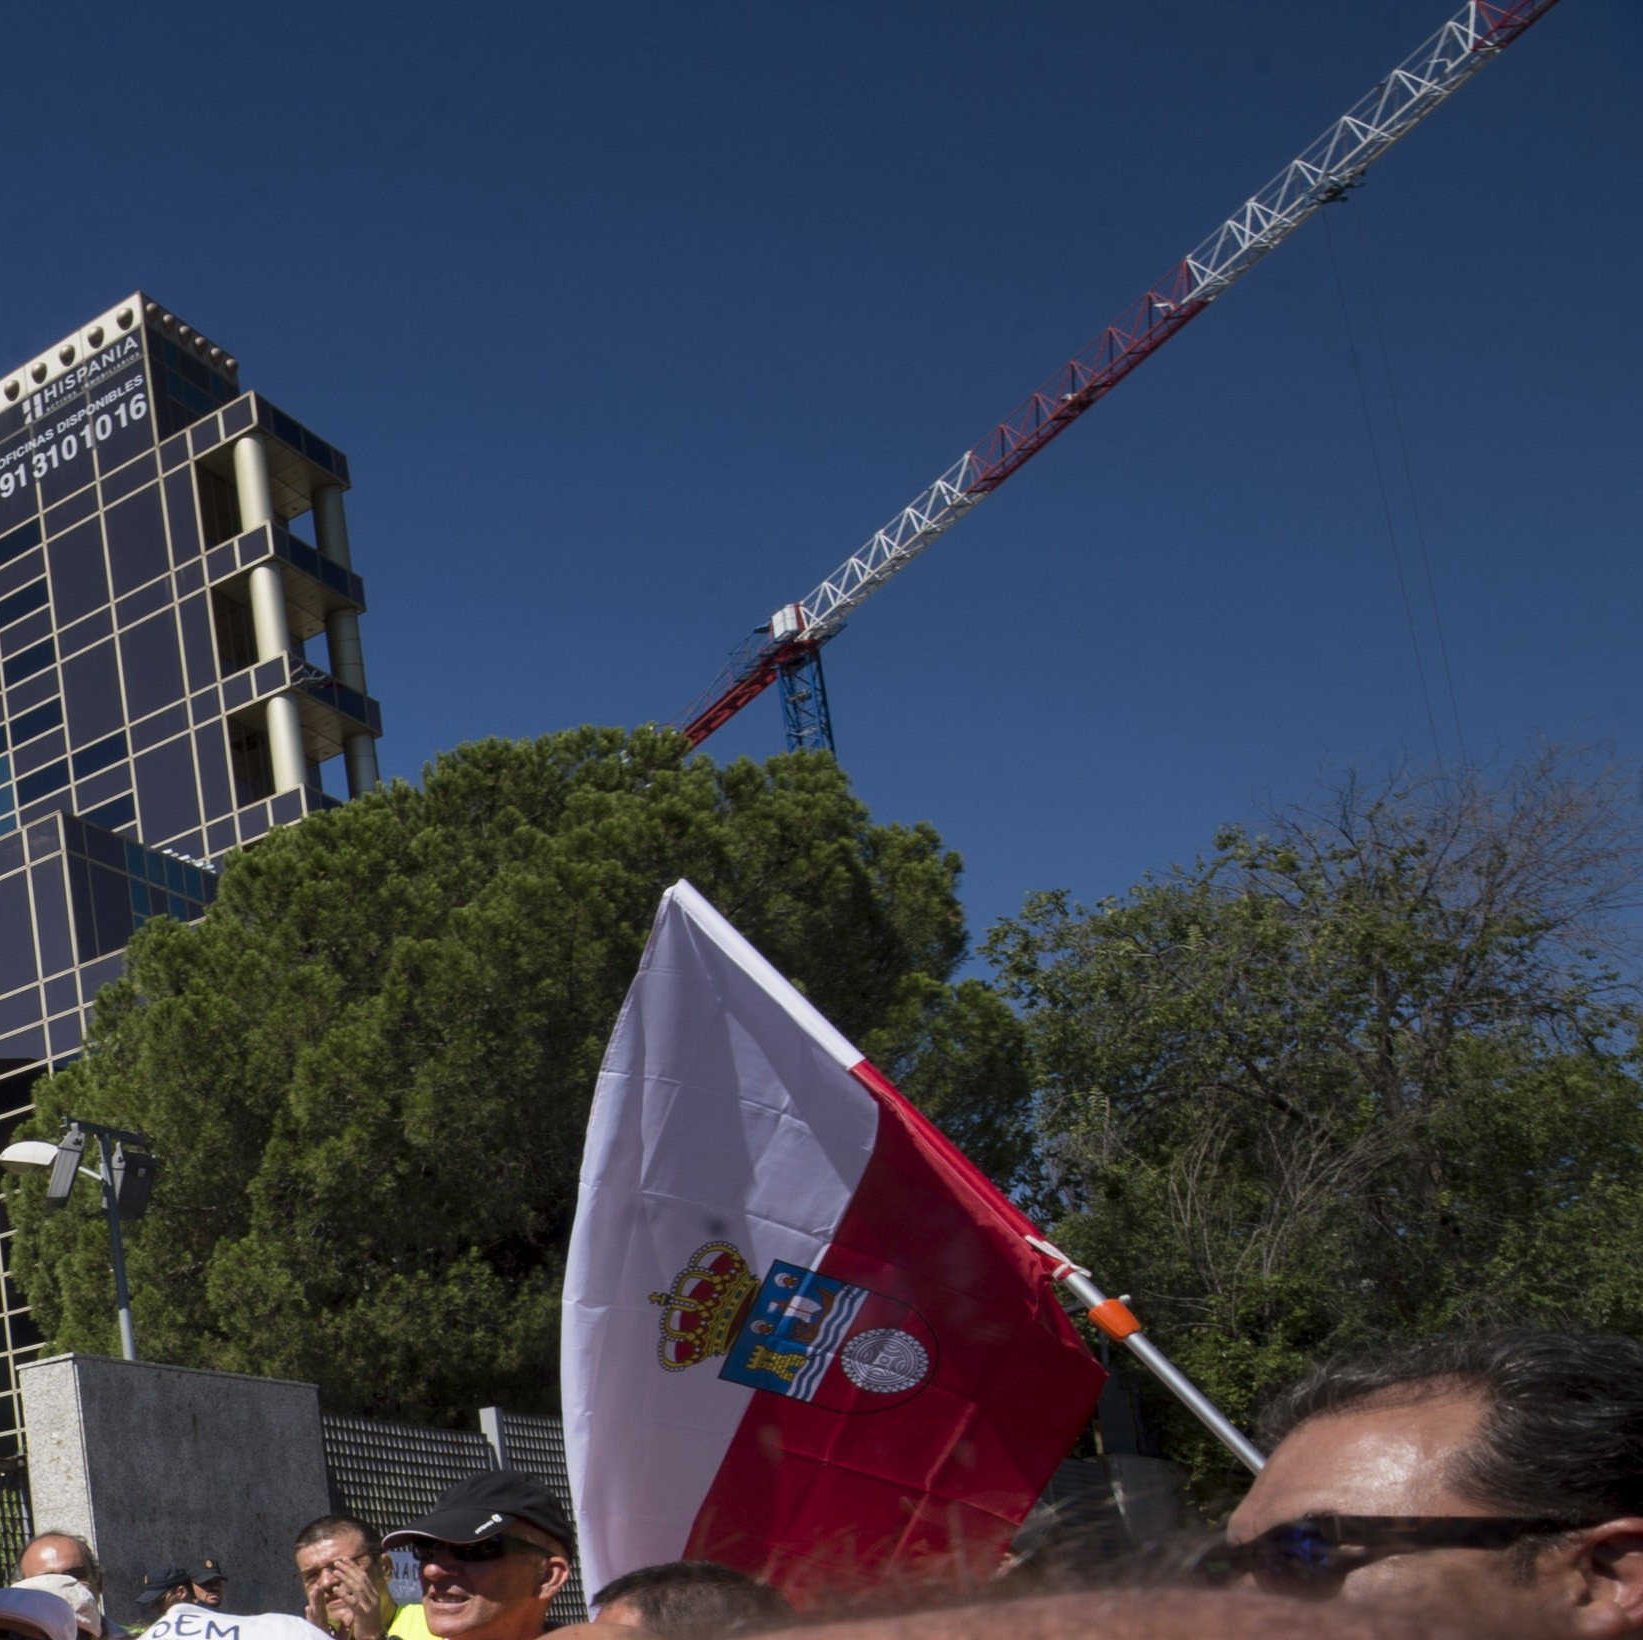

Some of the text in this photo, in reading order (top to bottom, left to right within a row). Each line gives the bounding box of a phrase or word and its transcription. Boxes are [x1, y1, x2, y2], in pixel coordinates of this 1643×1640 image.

[43, 336, 139, 403] HISPANIA
[56, 374, 144, 434] DISPONIBLES
[31, 434, 78, 479] 310
